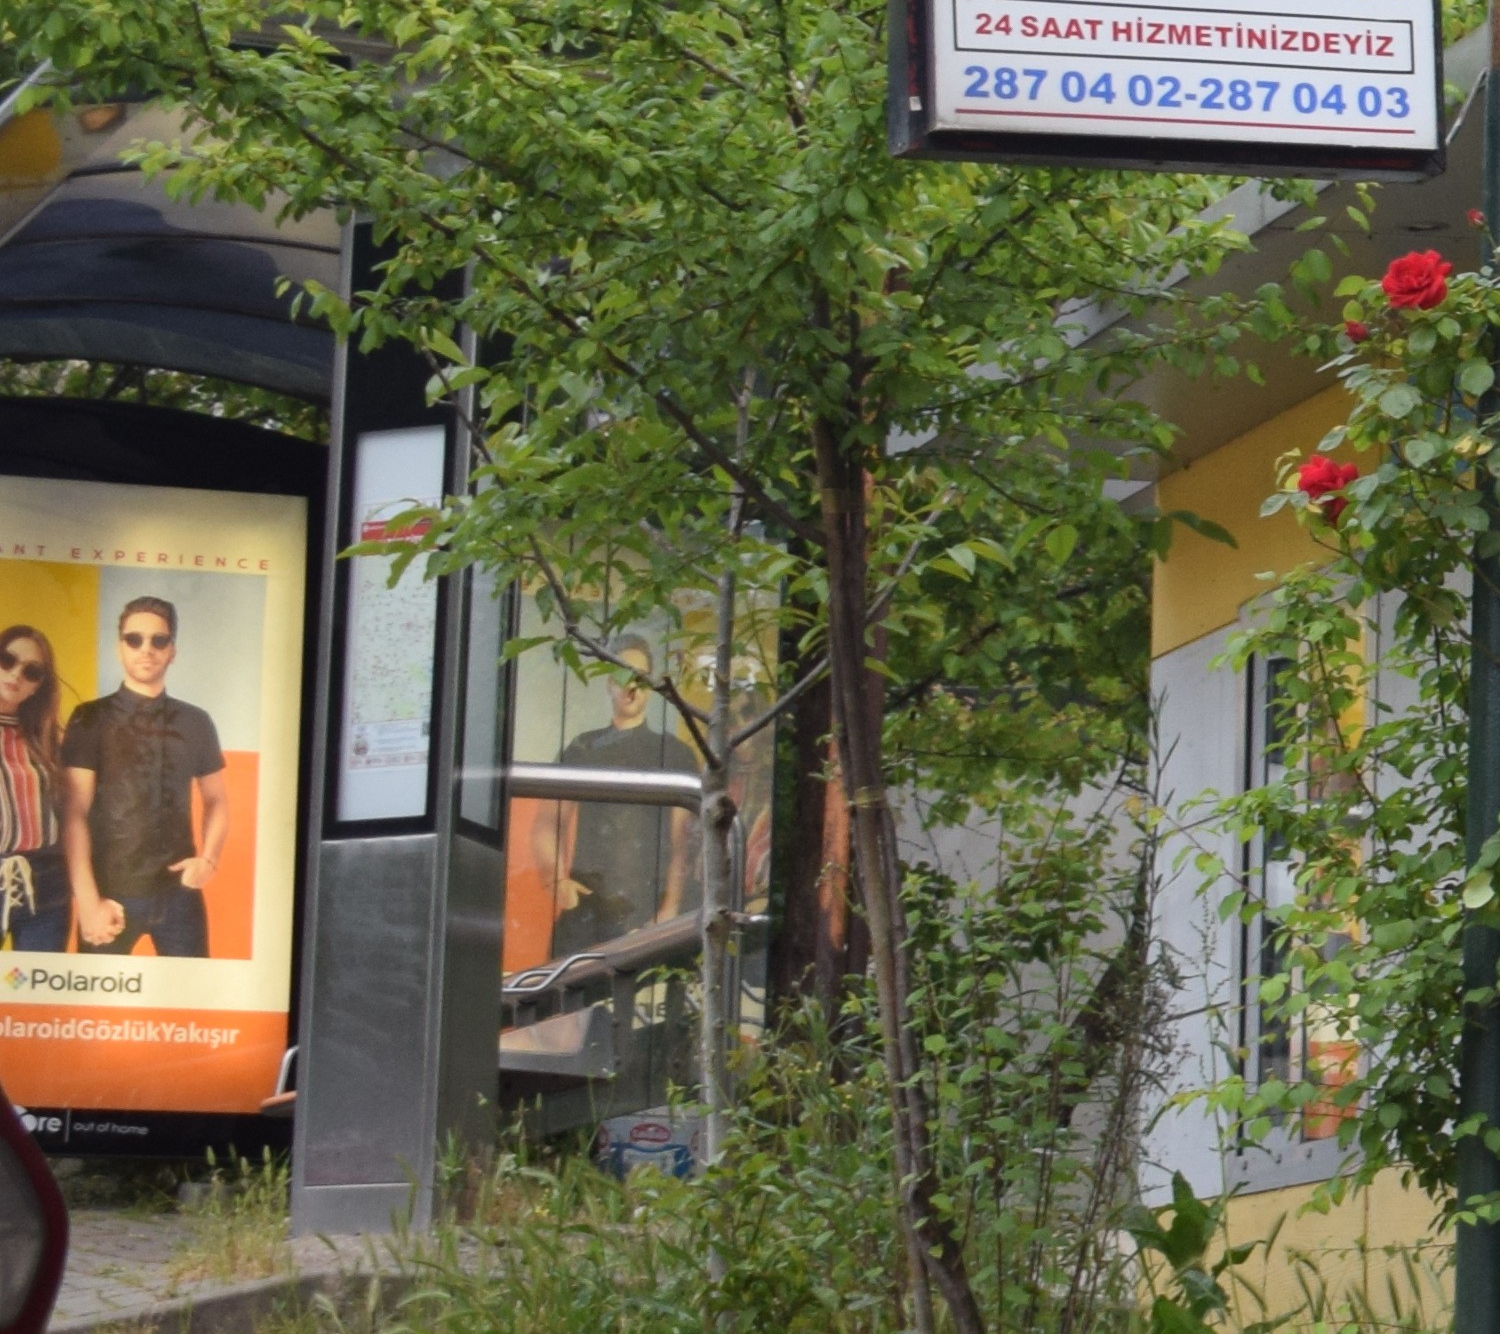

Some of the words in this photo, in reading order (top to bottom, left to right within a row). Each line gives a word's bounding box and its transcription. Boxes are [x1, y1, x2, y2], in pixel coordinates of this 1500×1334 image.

[975, 12, 1012, 37] 24
[1020, 15, 1102, 41] SAAT
[1113, 17, 1395, 57] HİZMETİNİZDEYİZ
[964, 65, 1045, 101] 287
[1061, 71, 1116, 105] 04
[1129, 74, 1281, 113] 02-287
[1293, 81, 1347, 116] 04
[1358, 86, 1411, 119] 03
[71, 547, 271, 570] EXPERIENCE
[31, 968, 143, 994] Polaroid
